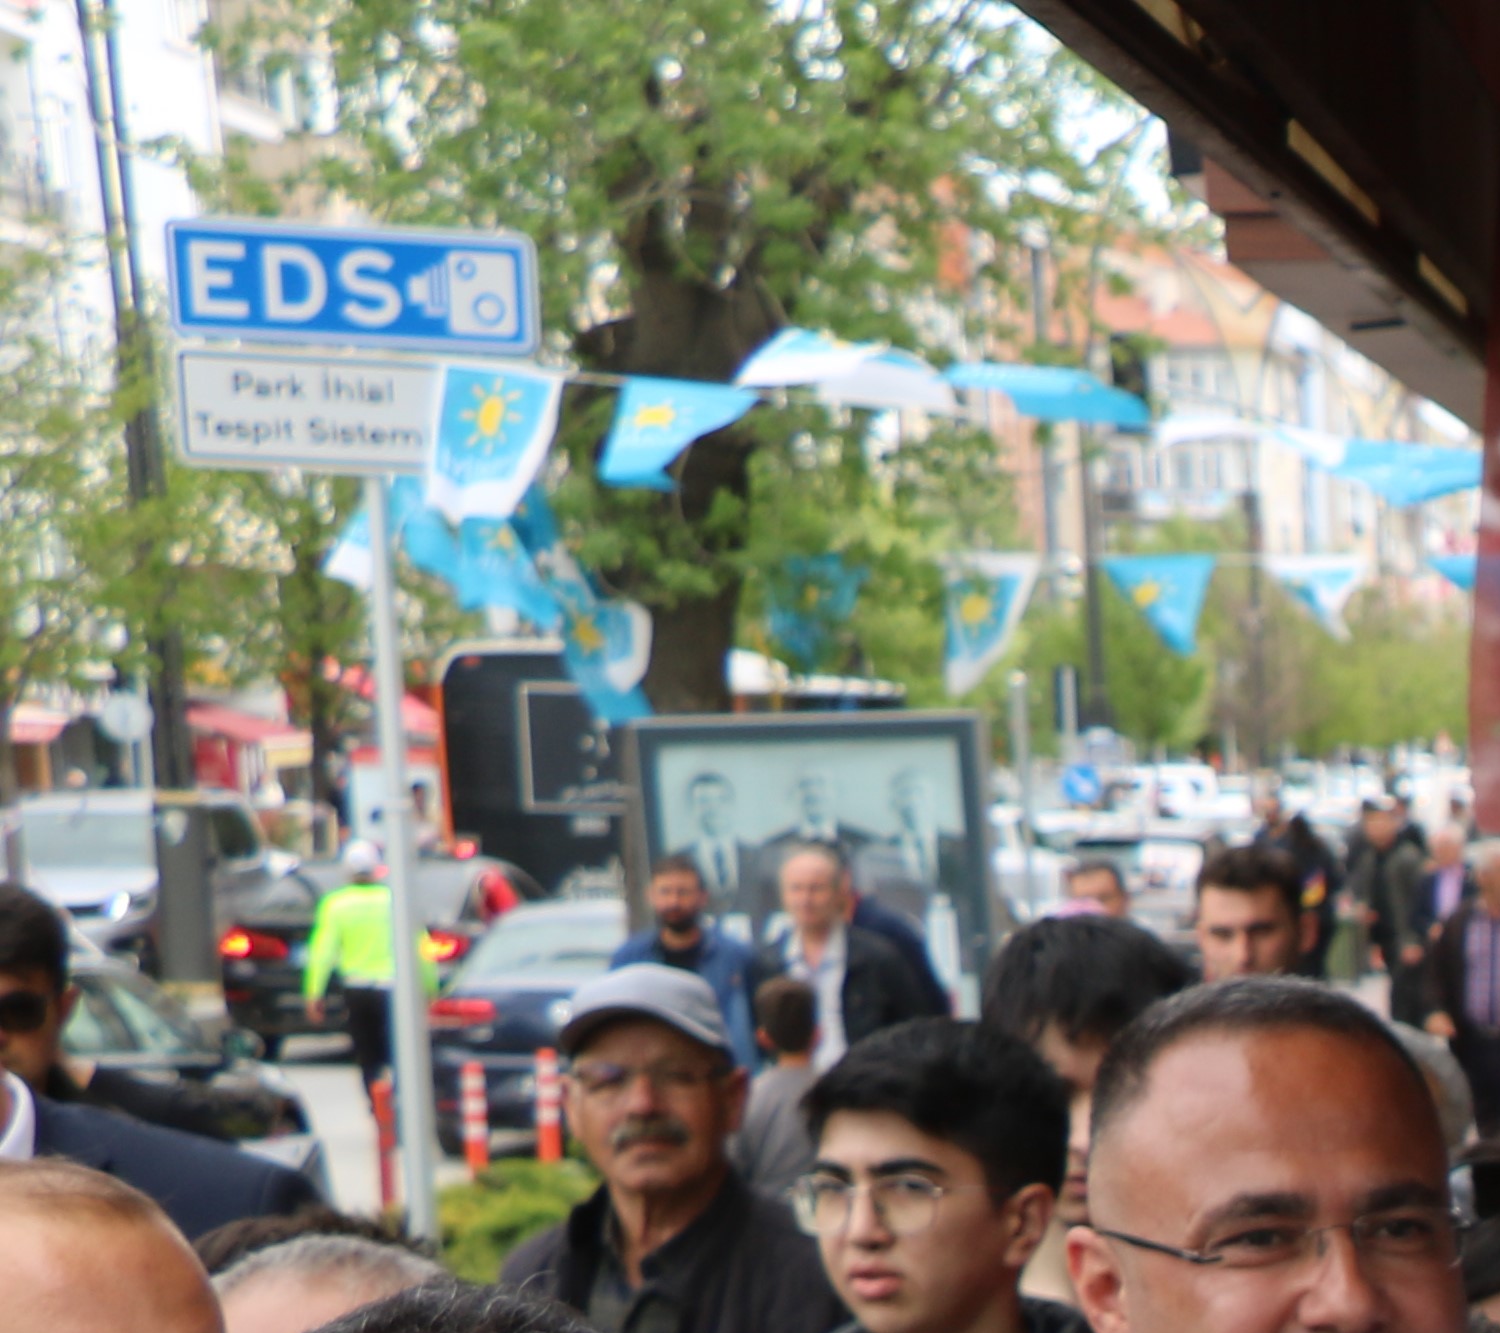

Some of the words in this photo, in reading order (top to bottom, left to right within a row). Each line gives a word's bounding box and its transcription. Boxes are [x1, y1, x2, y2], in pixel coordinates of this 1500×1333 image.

[187, 239, 403, 328] EDS
[232, 369, 305, 401] Park
[322, 369, 395, 404] İhlal
[197, 409, 294, 444] Tespit
